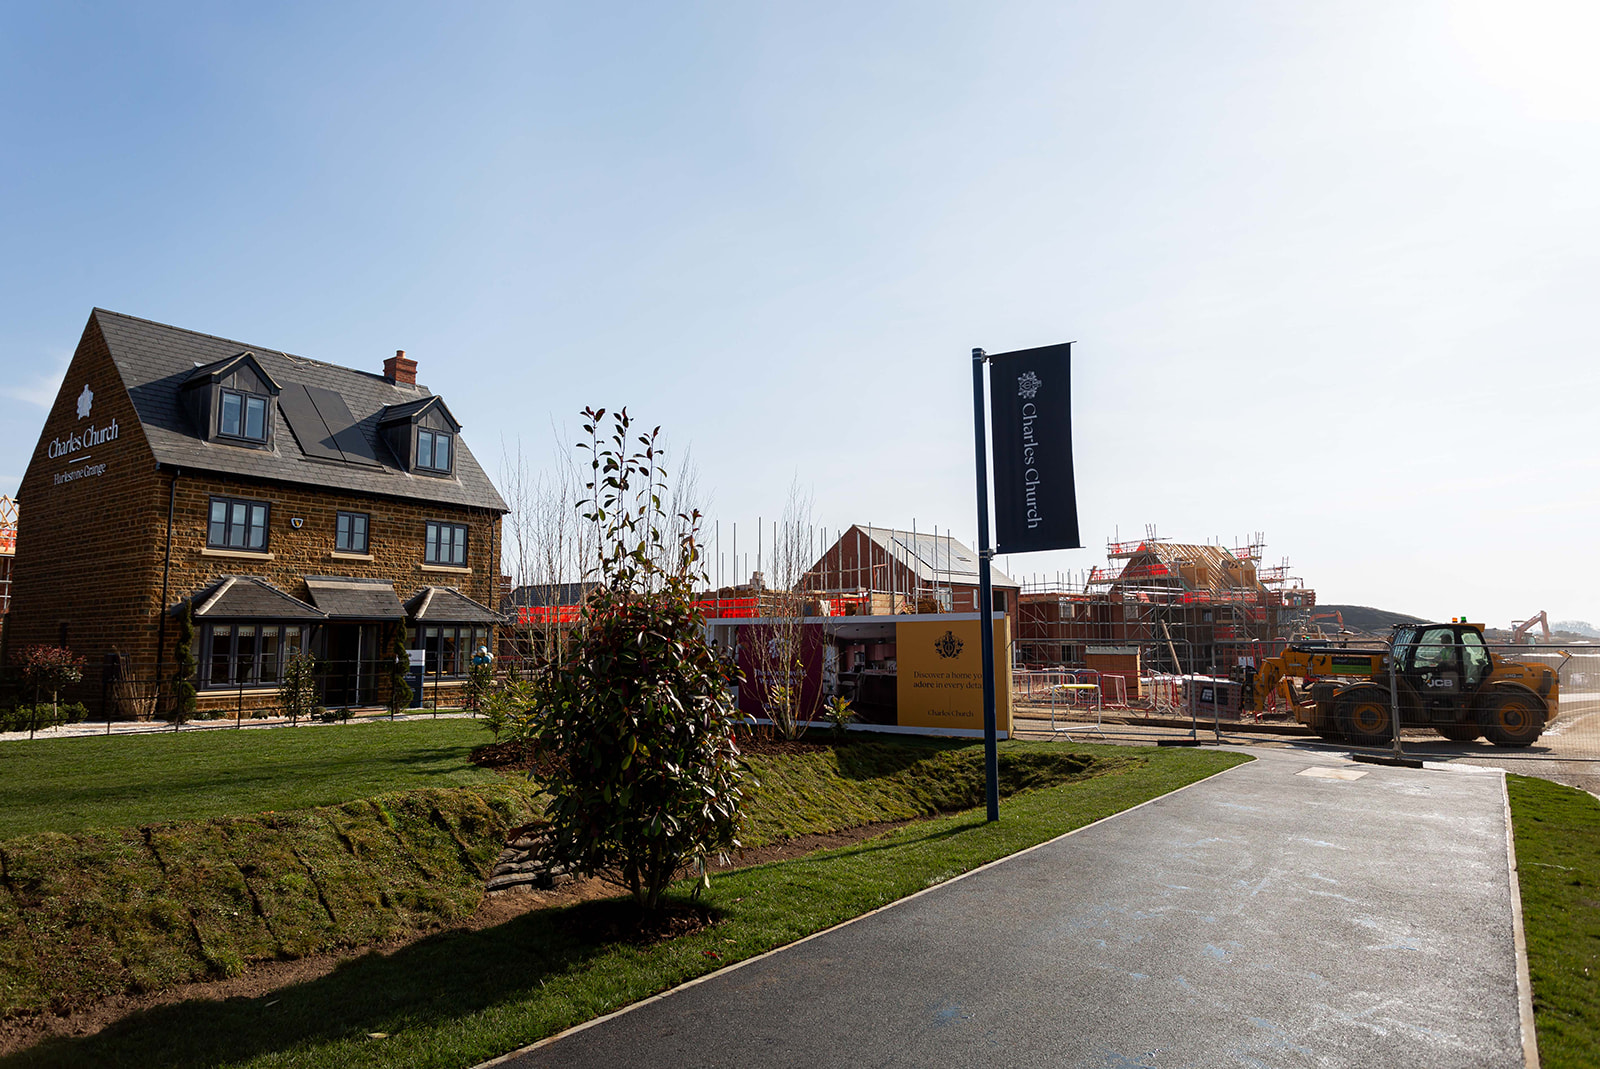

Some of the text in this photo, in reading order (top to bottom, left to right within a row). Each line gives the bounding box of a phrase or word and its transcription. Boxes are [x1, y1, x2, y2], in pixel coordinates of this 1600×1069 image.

[48, 418, 119, 459] Charles Church
[1022, 402, 1042, 529] Charles Church
[84, 463, 106, 477] Grange
[913, 671, 944, 679] Discover
[951, 671, 971, 679] home
[913, 681, 935, 689] adore
[936, 681, 943, 689] in
[966, 681, 983, 689] deta
[1427, 679, 1453, 687] JCB
[928, 709, 951, 717] Charles
